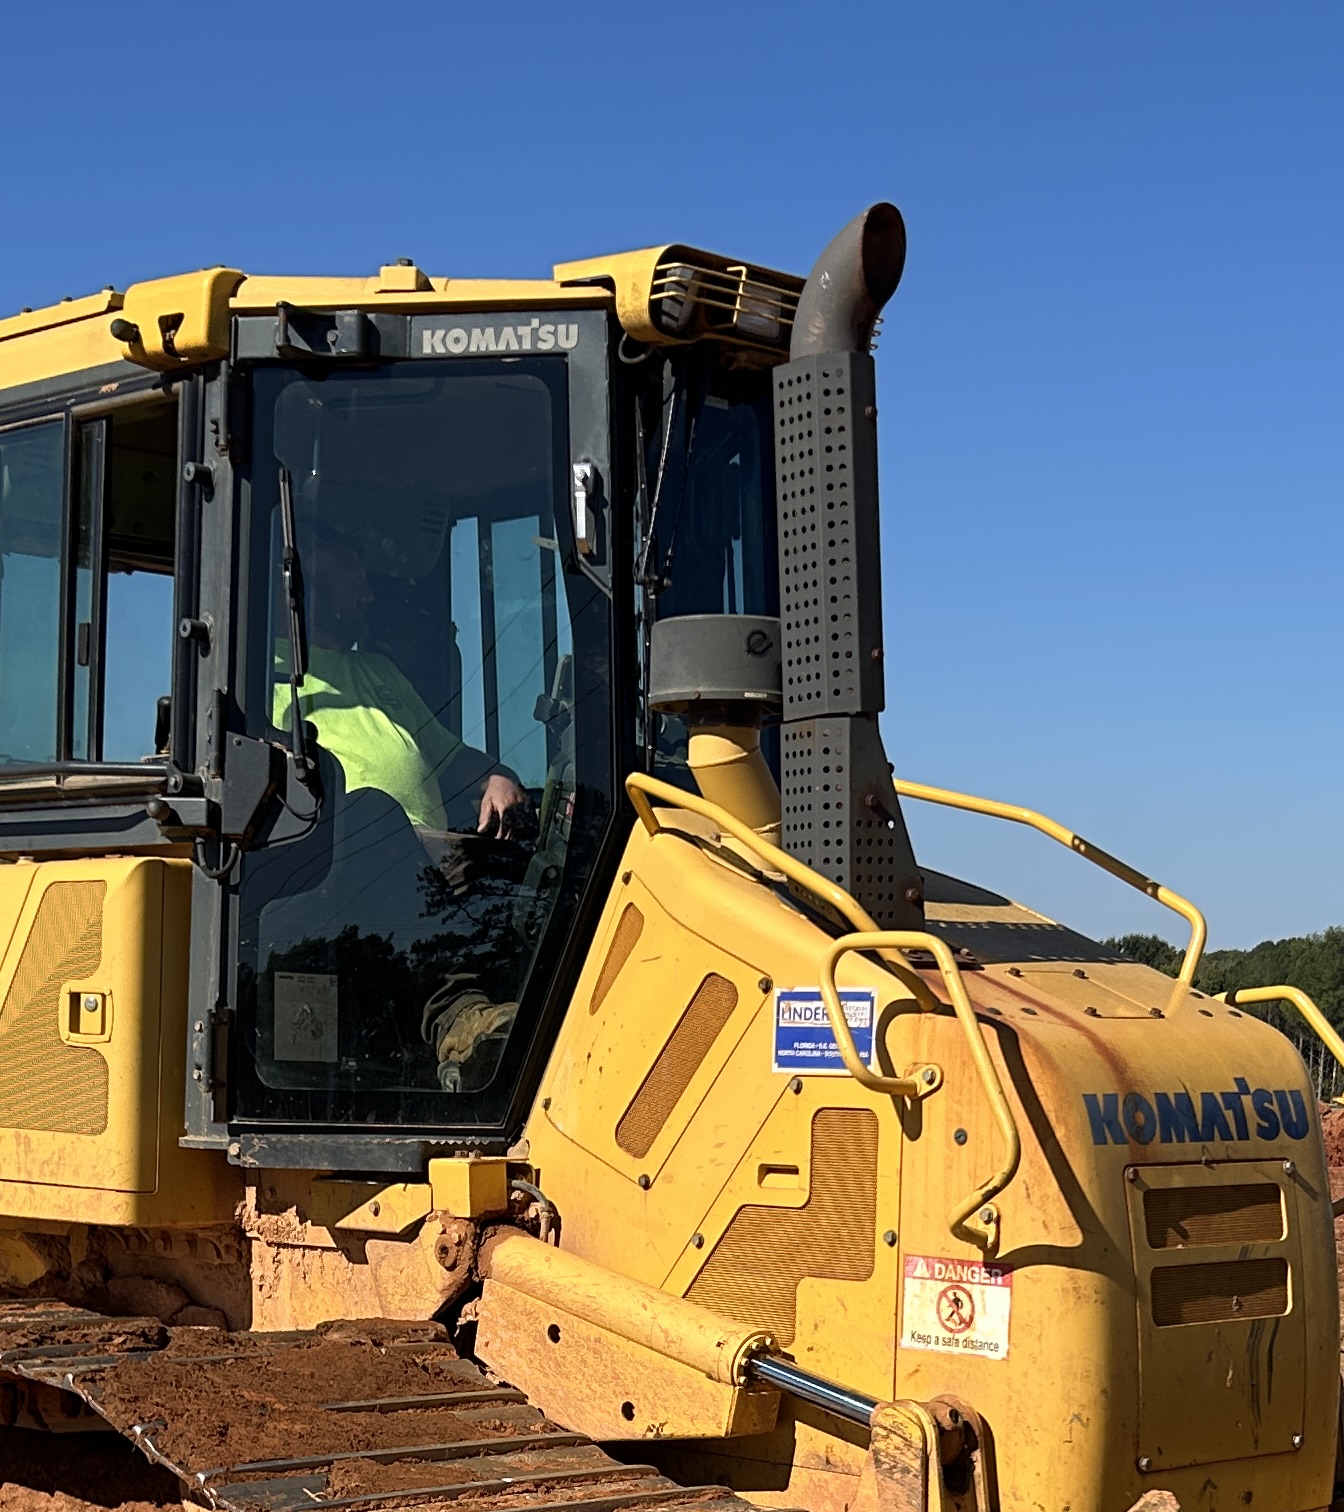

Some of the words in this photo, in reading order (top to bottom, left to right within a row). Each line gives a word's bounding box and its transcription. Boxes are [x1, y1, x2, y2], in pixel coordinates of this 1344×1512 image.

[422, 318, 579, 354] KOMATSU
[1082, 1077, 1310, 1145] KOMATSU
[934, 1263, 1003, 1285] DANGER
[910, 1330, 932, 1346] Keep
[941, 1334, 960, 1348] safe
[962, 1337, 1000, 1352] distance
